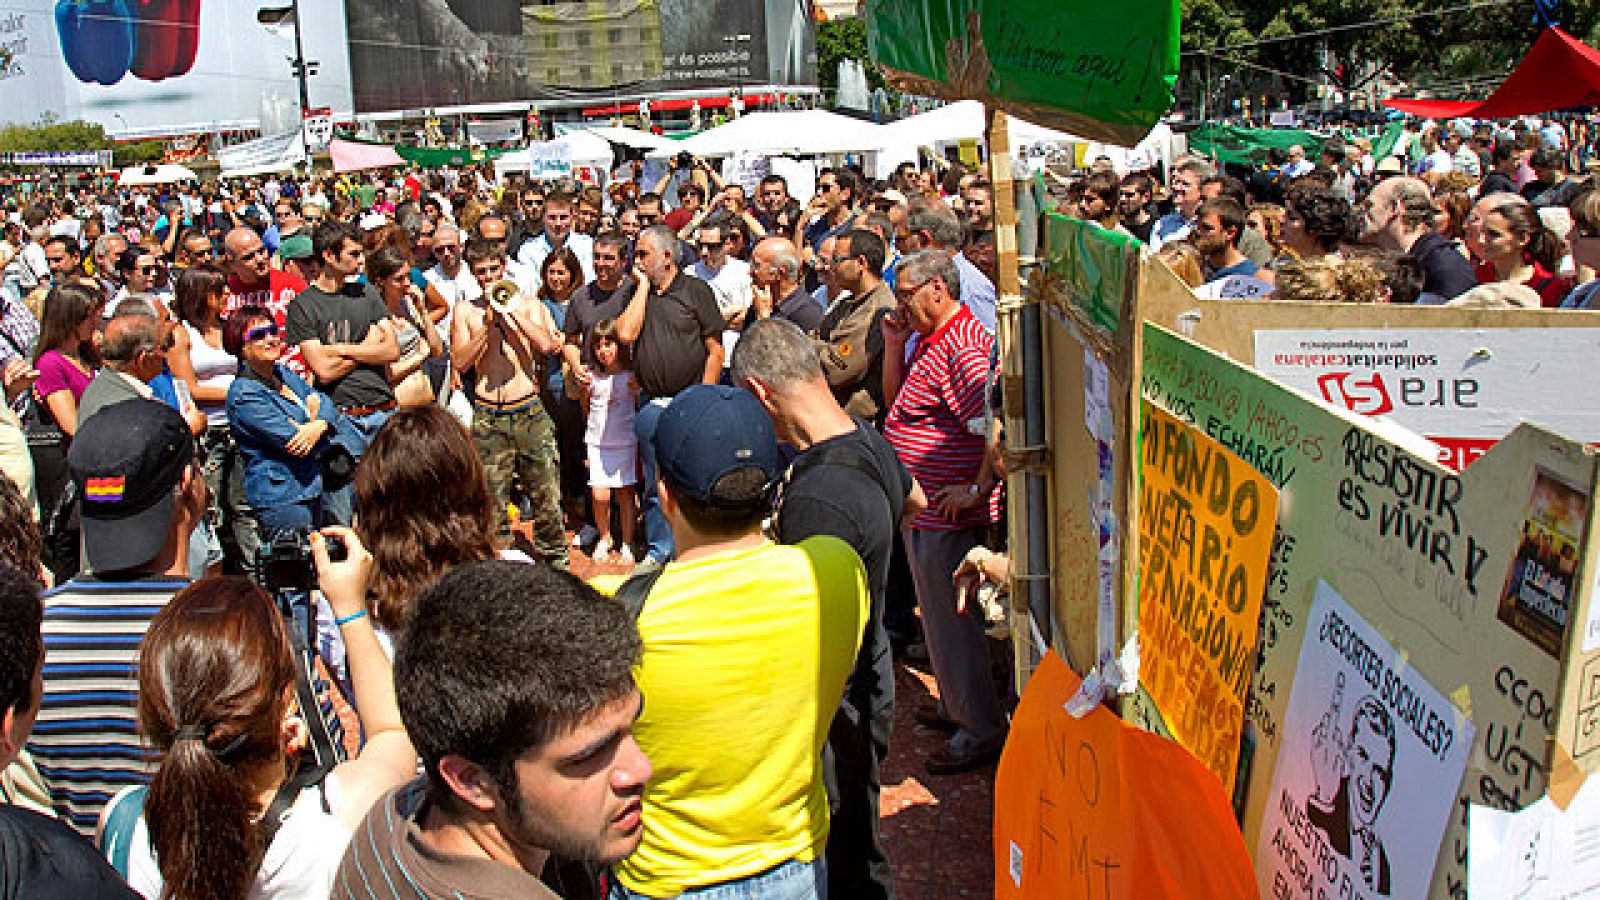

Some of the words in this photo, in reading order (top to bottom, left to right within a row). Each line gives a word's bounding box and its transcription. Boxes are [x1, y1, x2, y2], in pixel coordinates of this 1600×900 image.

[1400, 379, 1478, 409] ara
[1162, 421, 1260, 537] FONDO
[1045, 719, 1100, 808] NO
[1486, 721, 1543, 792] UGT
[1280, 789, 1338, 885] NUESTRO
